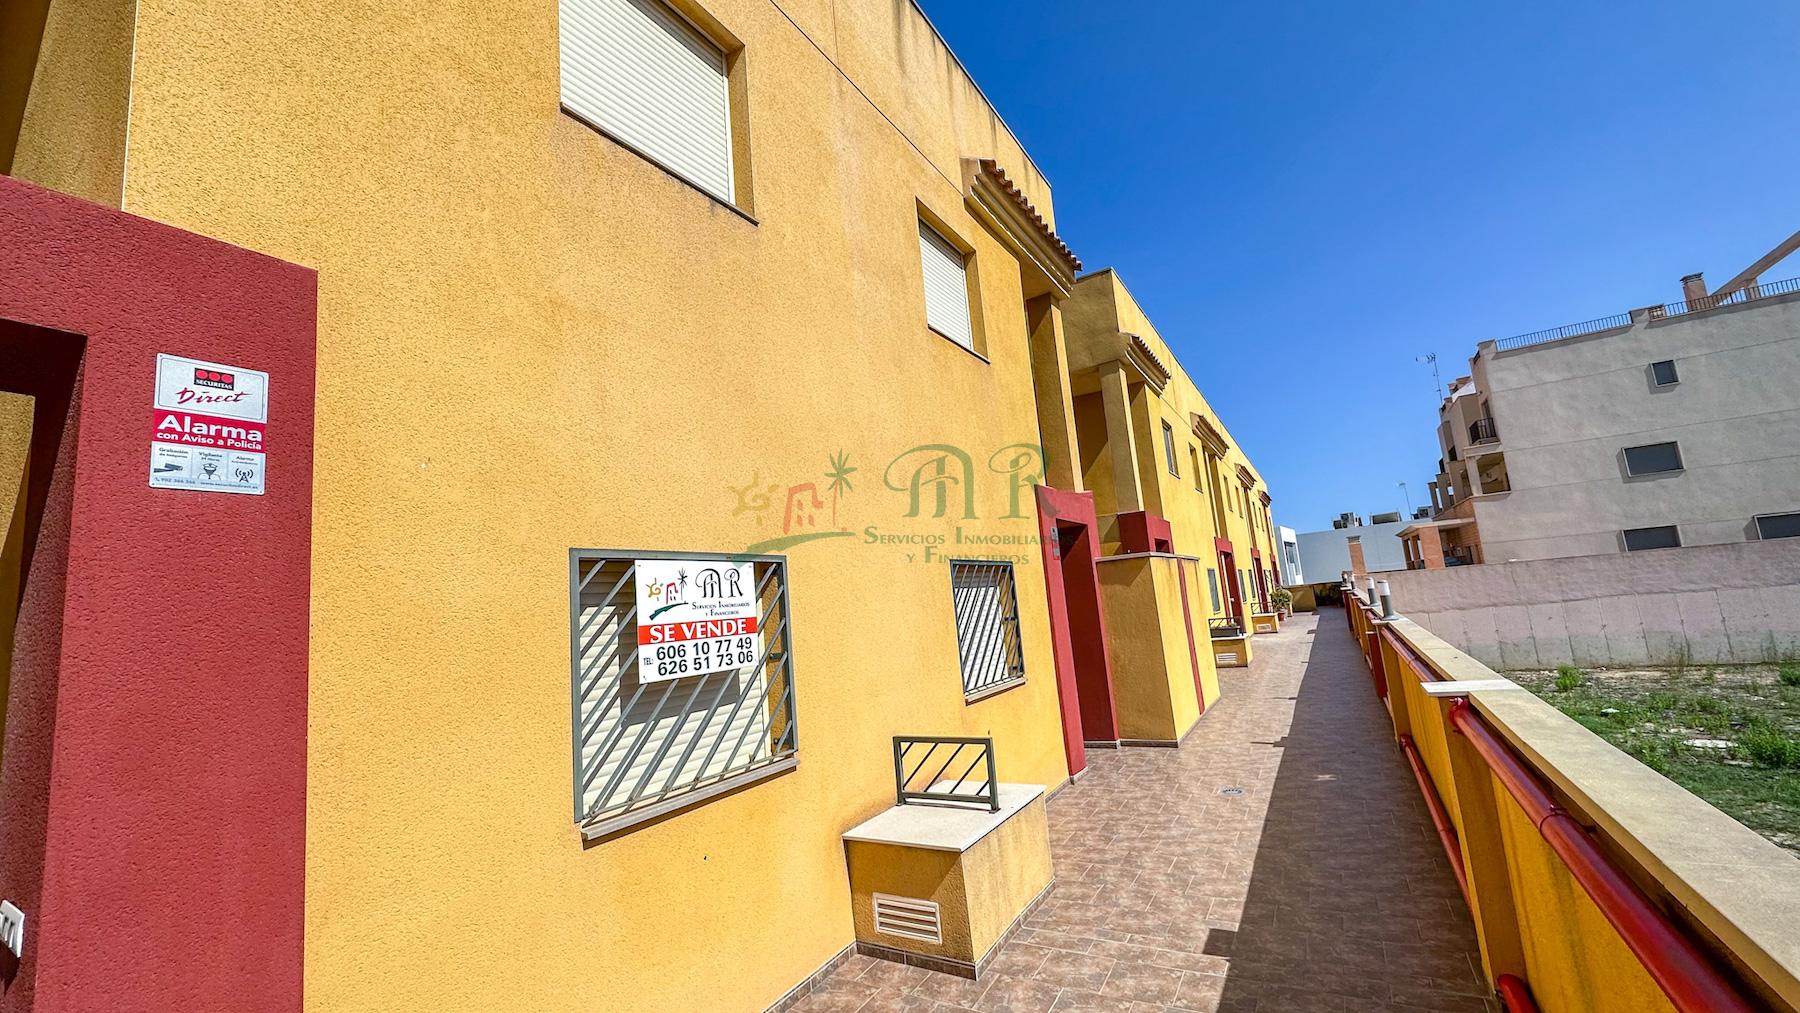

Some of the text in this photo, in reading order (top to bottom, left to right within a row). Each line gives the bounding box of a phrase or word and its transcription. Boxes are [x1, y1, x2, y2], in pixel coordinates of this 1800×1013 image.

[176, 387, 253, 404] Direct
[195, 379, 233, 390] SECURITAS
[158, 414, 262, 442] Alarma
[156, 432, 179, 440] con
[182, 434, 214, 444] Aviso
[227, 439, 262, 450] Policía
[649, 618, 747, 643] SE VENDE
[656, 637, 752, 660] 606 10 77 49
[658, 650, 754, 676] 626 51 73 06
